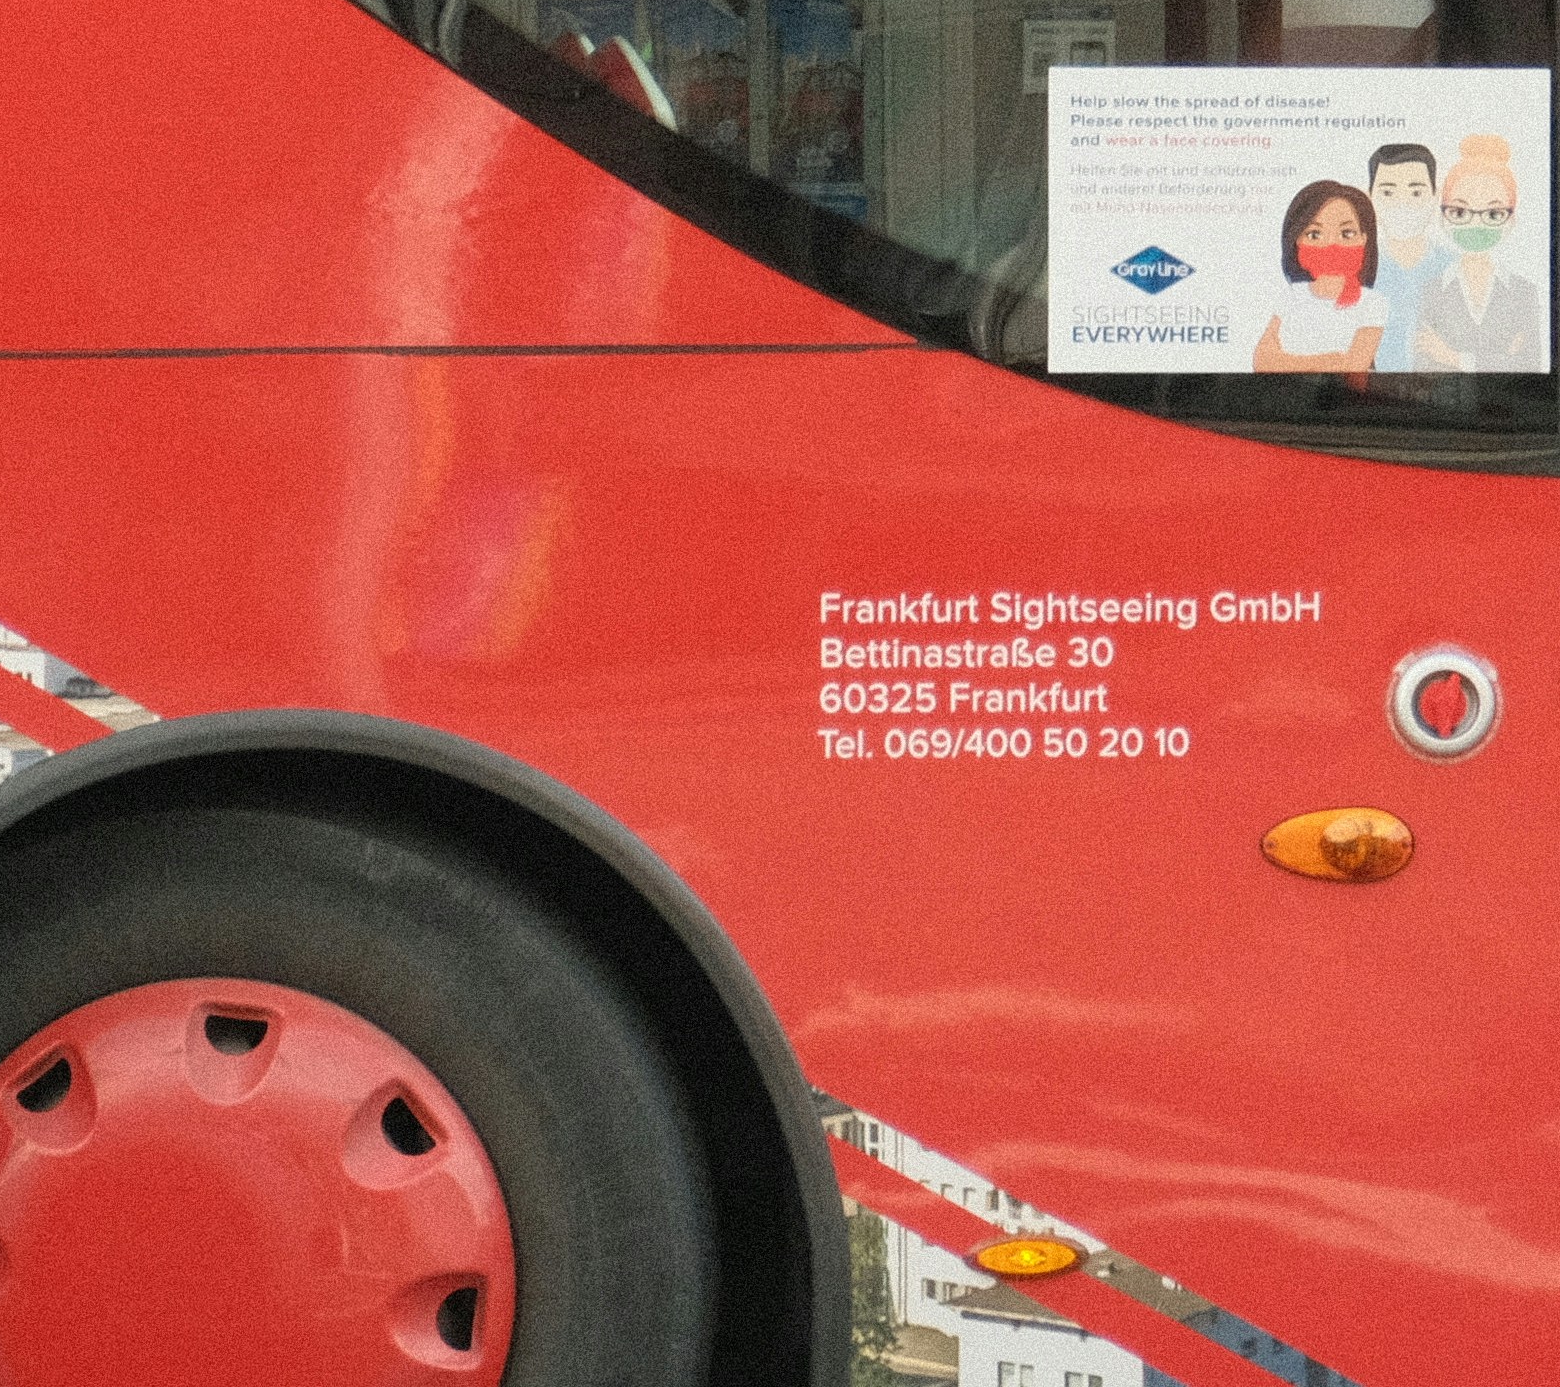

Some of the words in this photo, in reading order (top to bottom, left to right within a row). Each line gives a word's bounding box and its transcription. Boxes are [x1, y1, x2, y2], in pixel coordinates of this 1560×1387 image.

[1070, 95, 1107, 110] Help
[1113, 95, 1150, 108] slow
[1154, 95, 1180, 108] the
[1185, 95, 1240, 110] spread
[1244, 95, 1261, 108] of
[1264, 95, 1331, 108] disease!
[1070, 115, 1123, 128] Please
[1128, 116, 1188, 129] respect
[1192, 115, 1219, 128] the
[1223, 116, 1320, 130] government
[1324, 115, 1407, 130] regulation
[1070, 134, 1101, 147] and
[1106, 137, 1145, 148] wear
[1149, 137, 1159, 147] a
[1163, 134, 1198, 148] face
[1116, 262, 1155, 278] Gray
[1157, 260, 1190, 278] Line
[1071, 304, 1231, 325] SIGHTSEEING
[1071, 325, 1230, 344] EVERYWHERE
[820, 592, 980, 624] Frankfurt
[990, 591, 1197, 630] Sightseeing
[1209, 590, 1322, 623] GmbH
[820, 636, 1057, 669] Bettinastraße
[1068, 636, 1115, 668] 30
[819, 681, 938, 714] 60325
[950, 681, 1109, 713] Frankfurt
[818, 728, 874, 759] Tel.
[884, 727, 1033, 759] 069/400
[1043, 727, 1089, 758] 50
[1098, 727, 1143, 758] 20
[1154, 727, 1191, 758] 10
